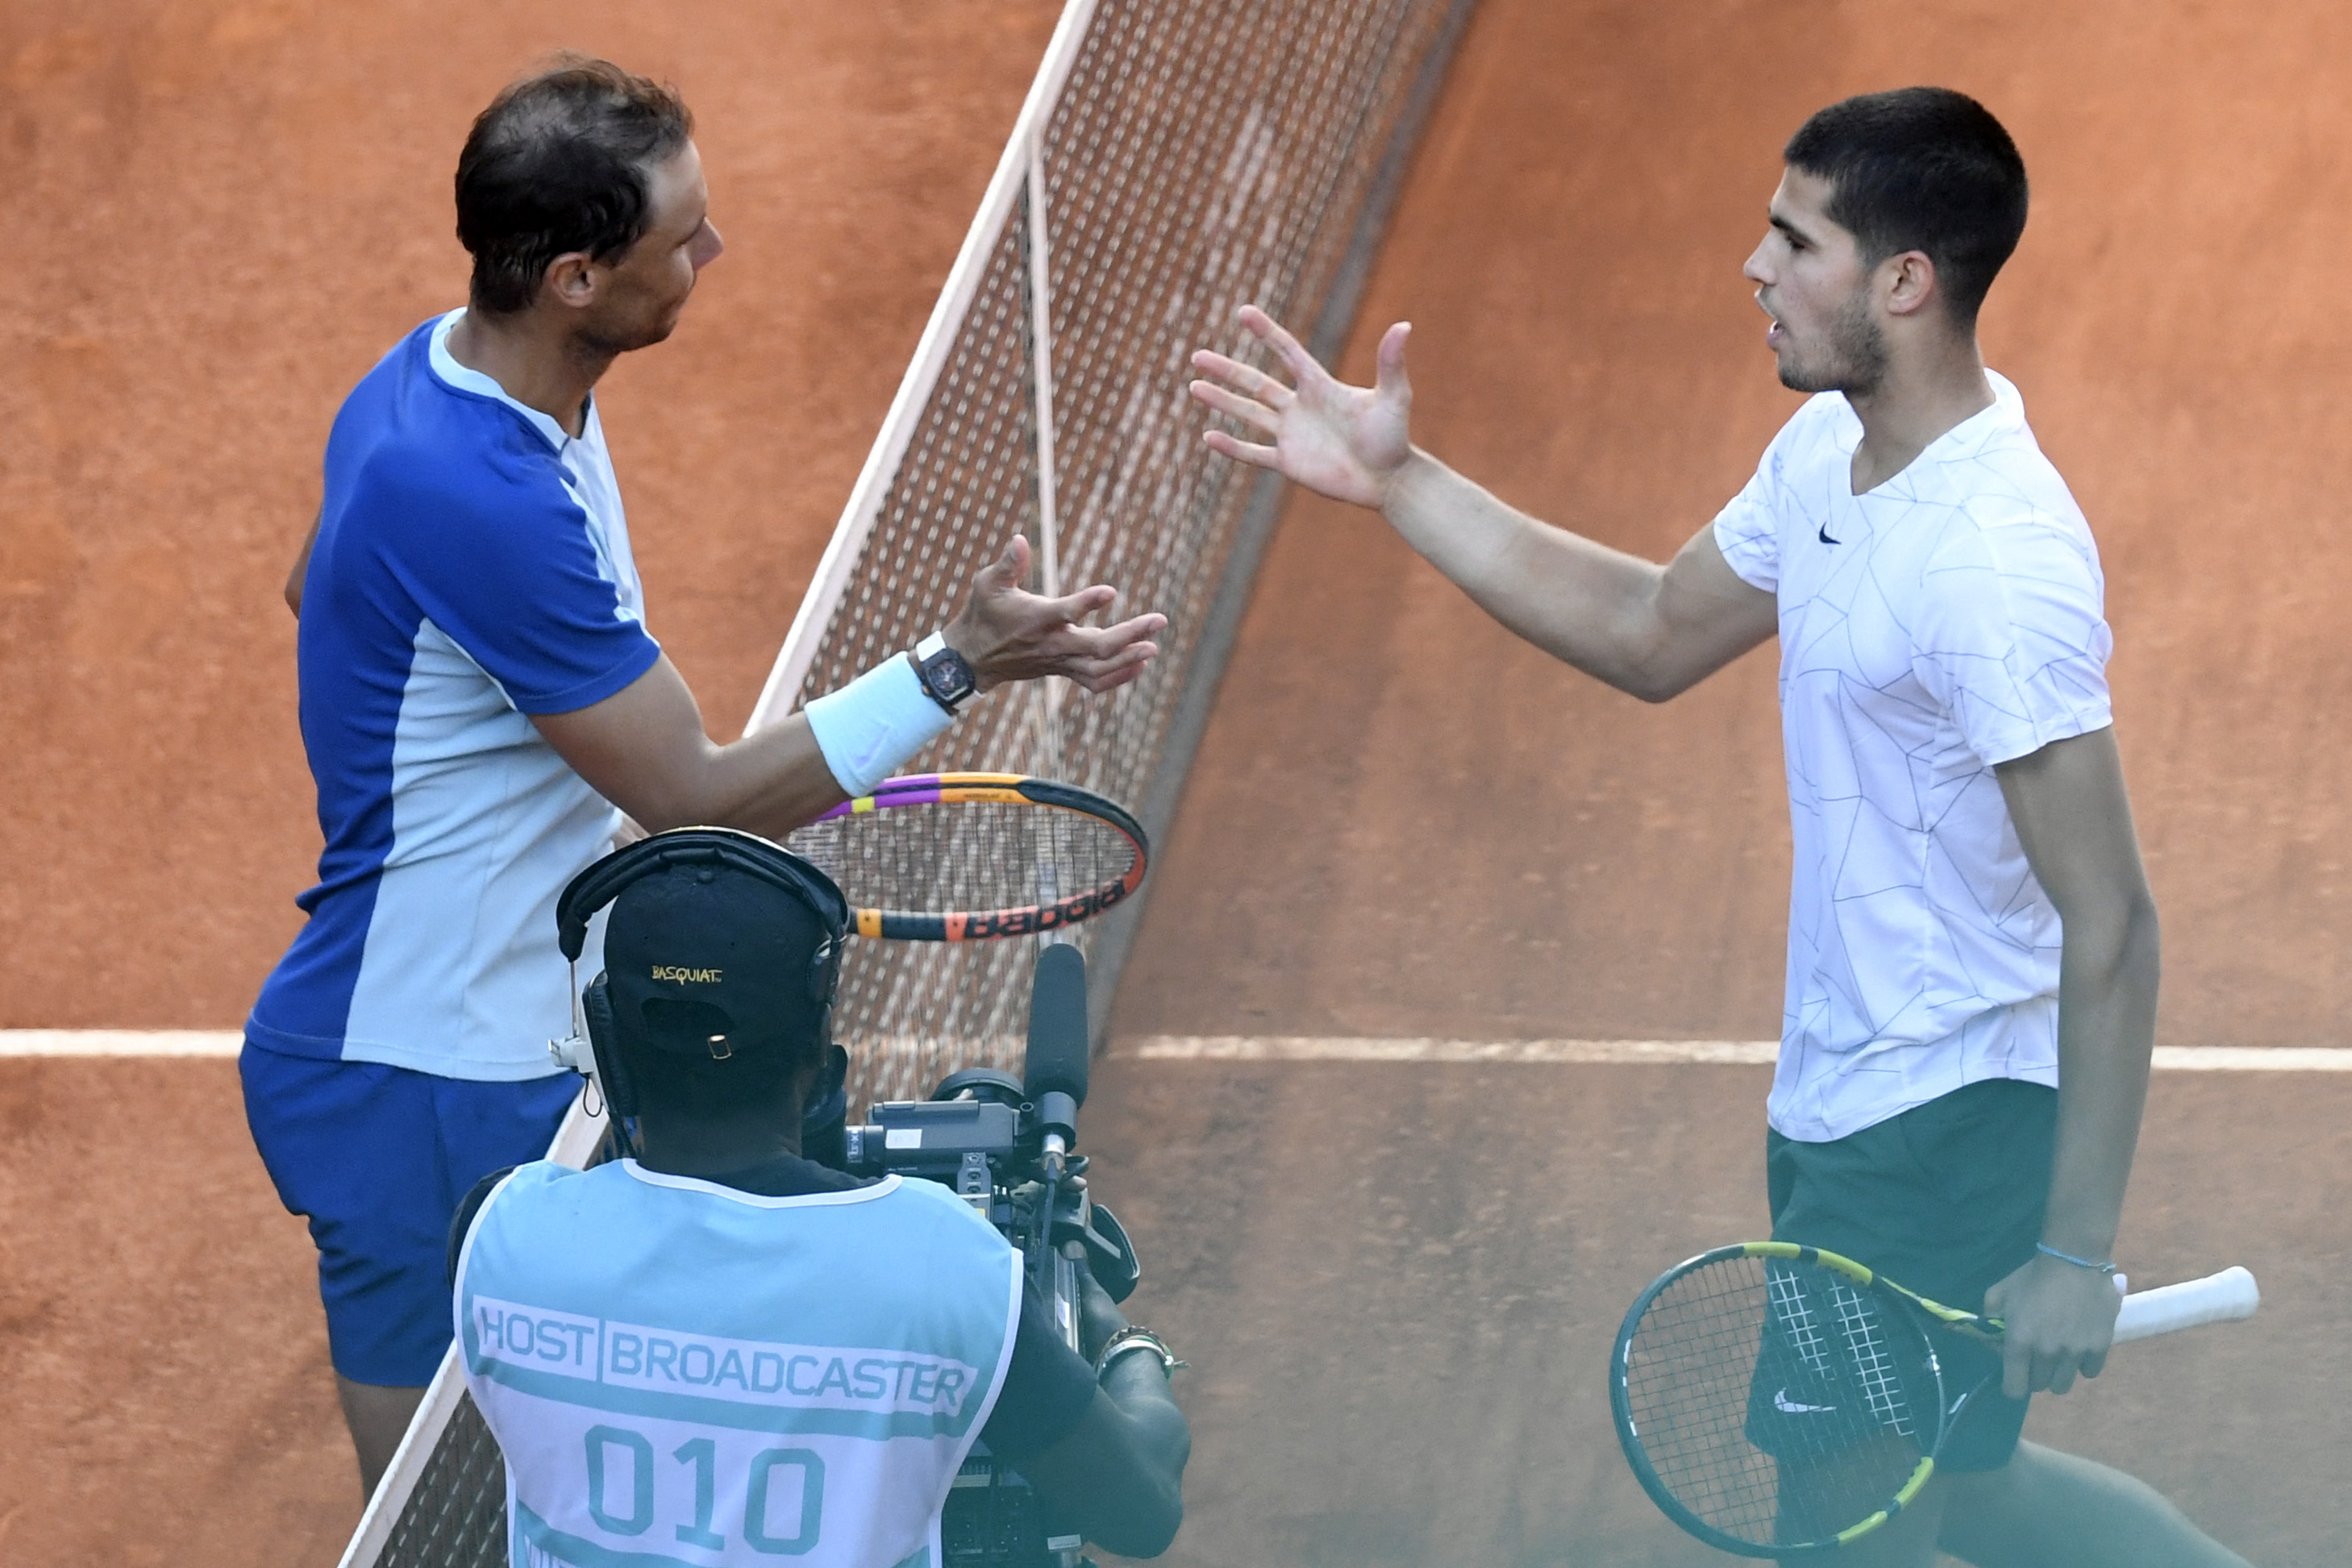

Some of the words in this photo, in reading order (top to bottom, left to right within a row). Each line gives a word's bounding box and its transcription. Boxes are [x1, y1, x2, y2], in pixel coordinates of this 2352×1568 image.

[651, 965, 722, 986] BASQUIAT
[480, 1305, 594, 1365] HOST
[610, 1334, 966, 1407] BROADCASTER
[585, 1424, 826, 1556] 010
